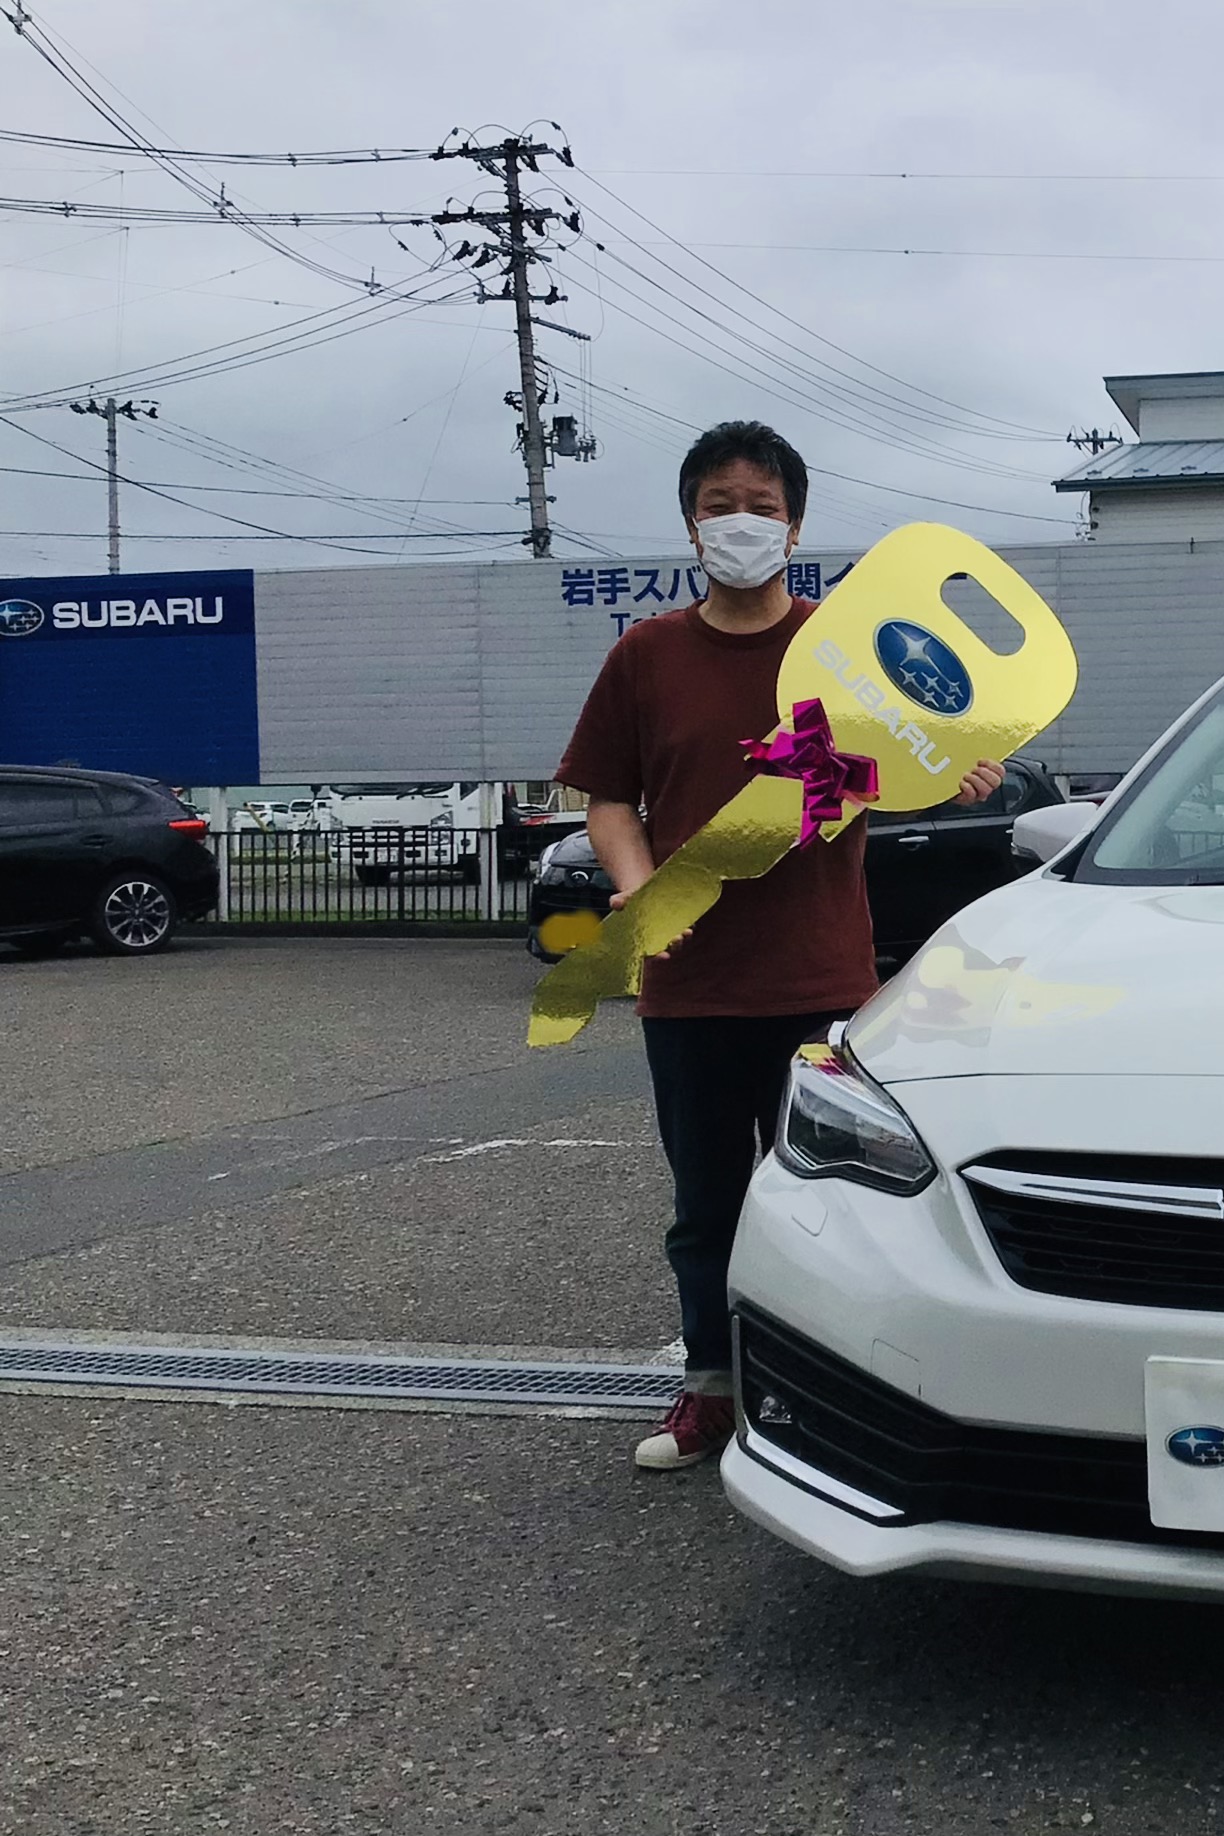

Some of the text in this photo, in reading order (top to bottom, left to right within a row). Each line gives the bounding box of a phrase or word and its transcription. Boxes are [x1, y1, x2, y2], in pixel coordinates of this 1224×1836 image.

[561, 565, 708, 606] 岩手スバ
[52, 597, 223, 629] SUBARU
[812, 639, 951, 775] SUBARU
